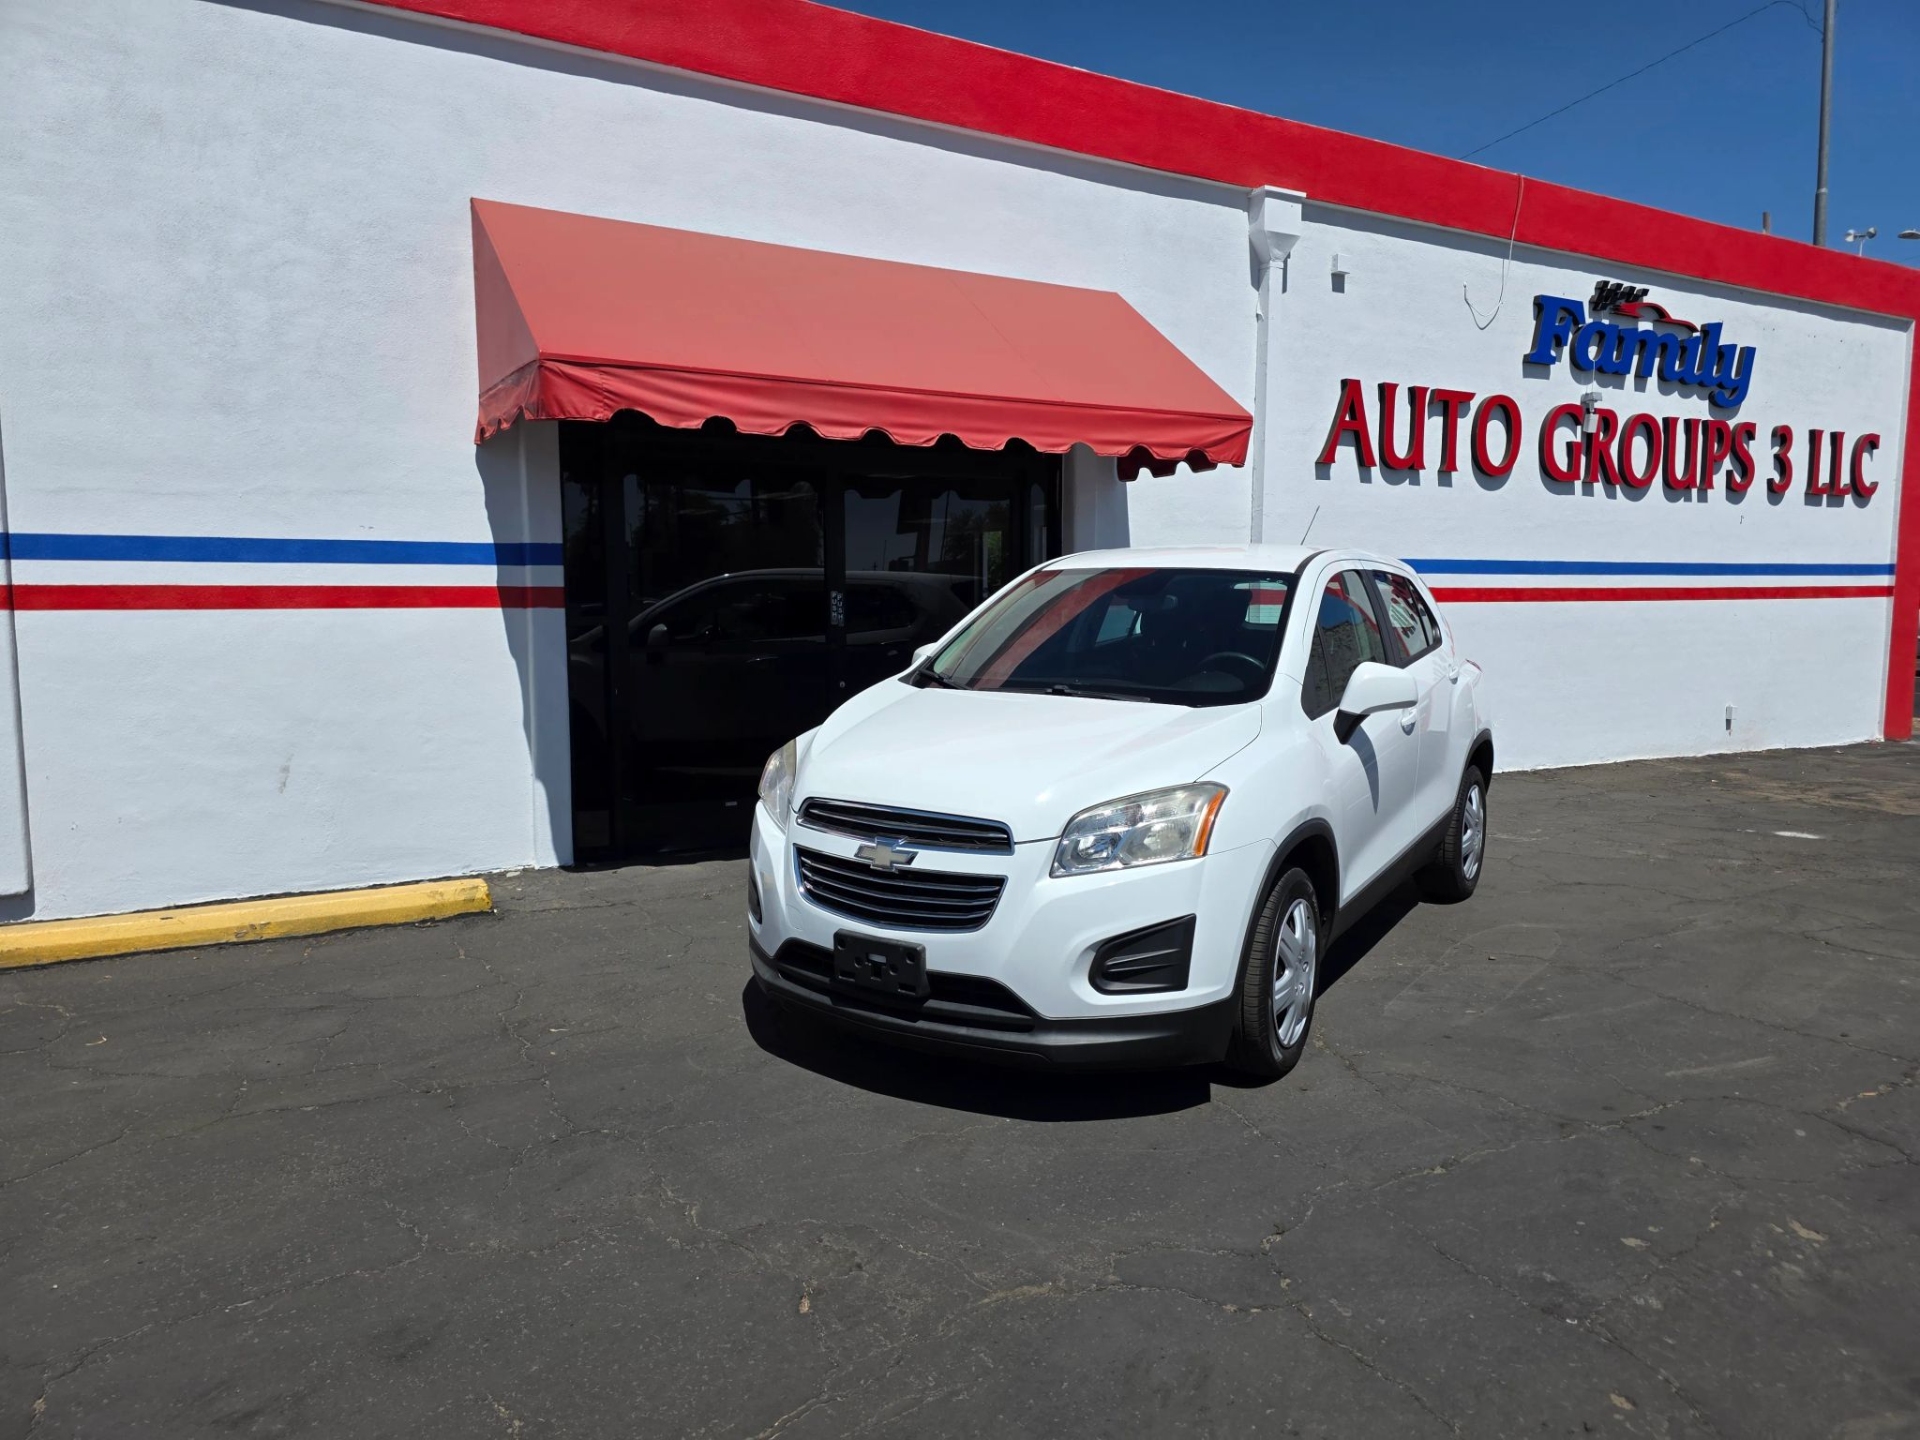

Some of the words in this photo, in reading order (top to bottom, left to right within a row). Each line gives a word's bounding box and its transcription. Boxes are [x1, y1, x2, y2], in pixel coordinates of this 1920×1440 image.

[1525, 294, 1757, 408] Family
[1318, 378, 1522, 477] AUTO
[1539, 402, 1757, 493] GROUPS
[1768, 425, 1793, 494] 3
[1807, 428, 1880, 498] LLC
